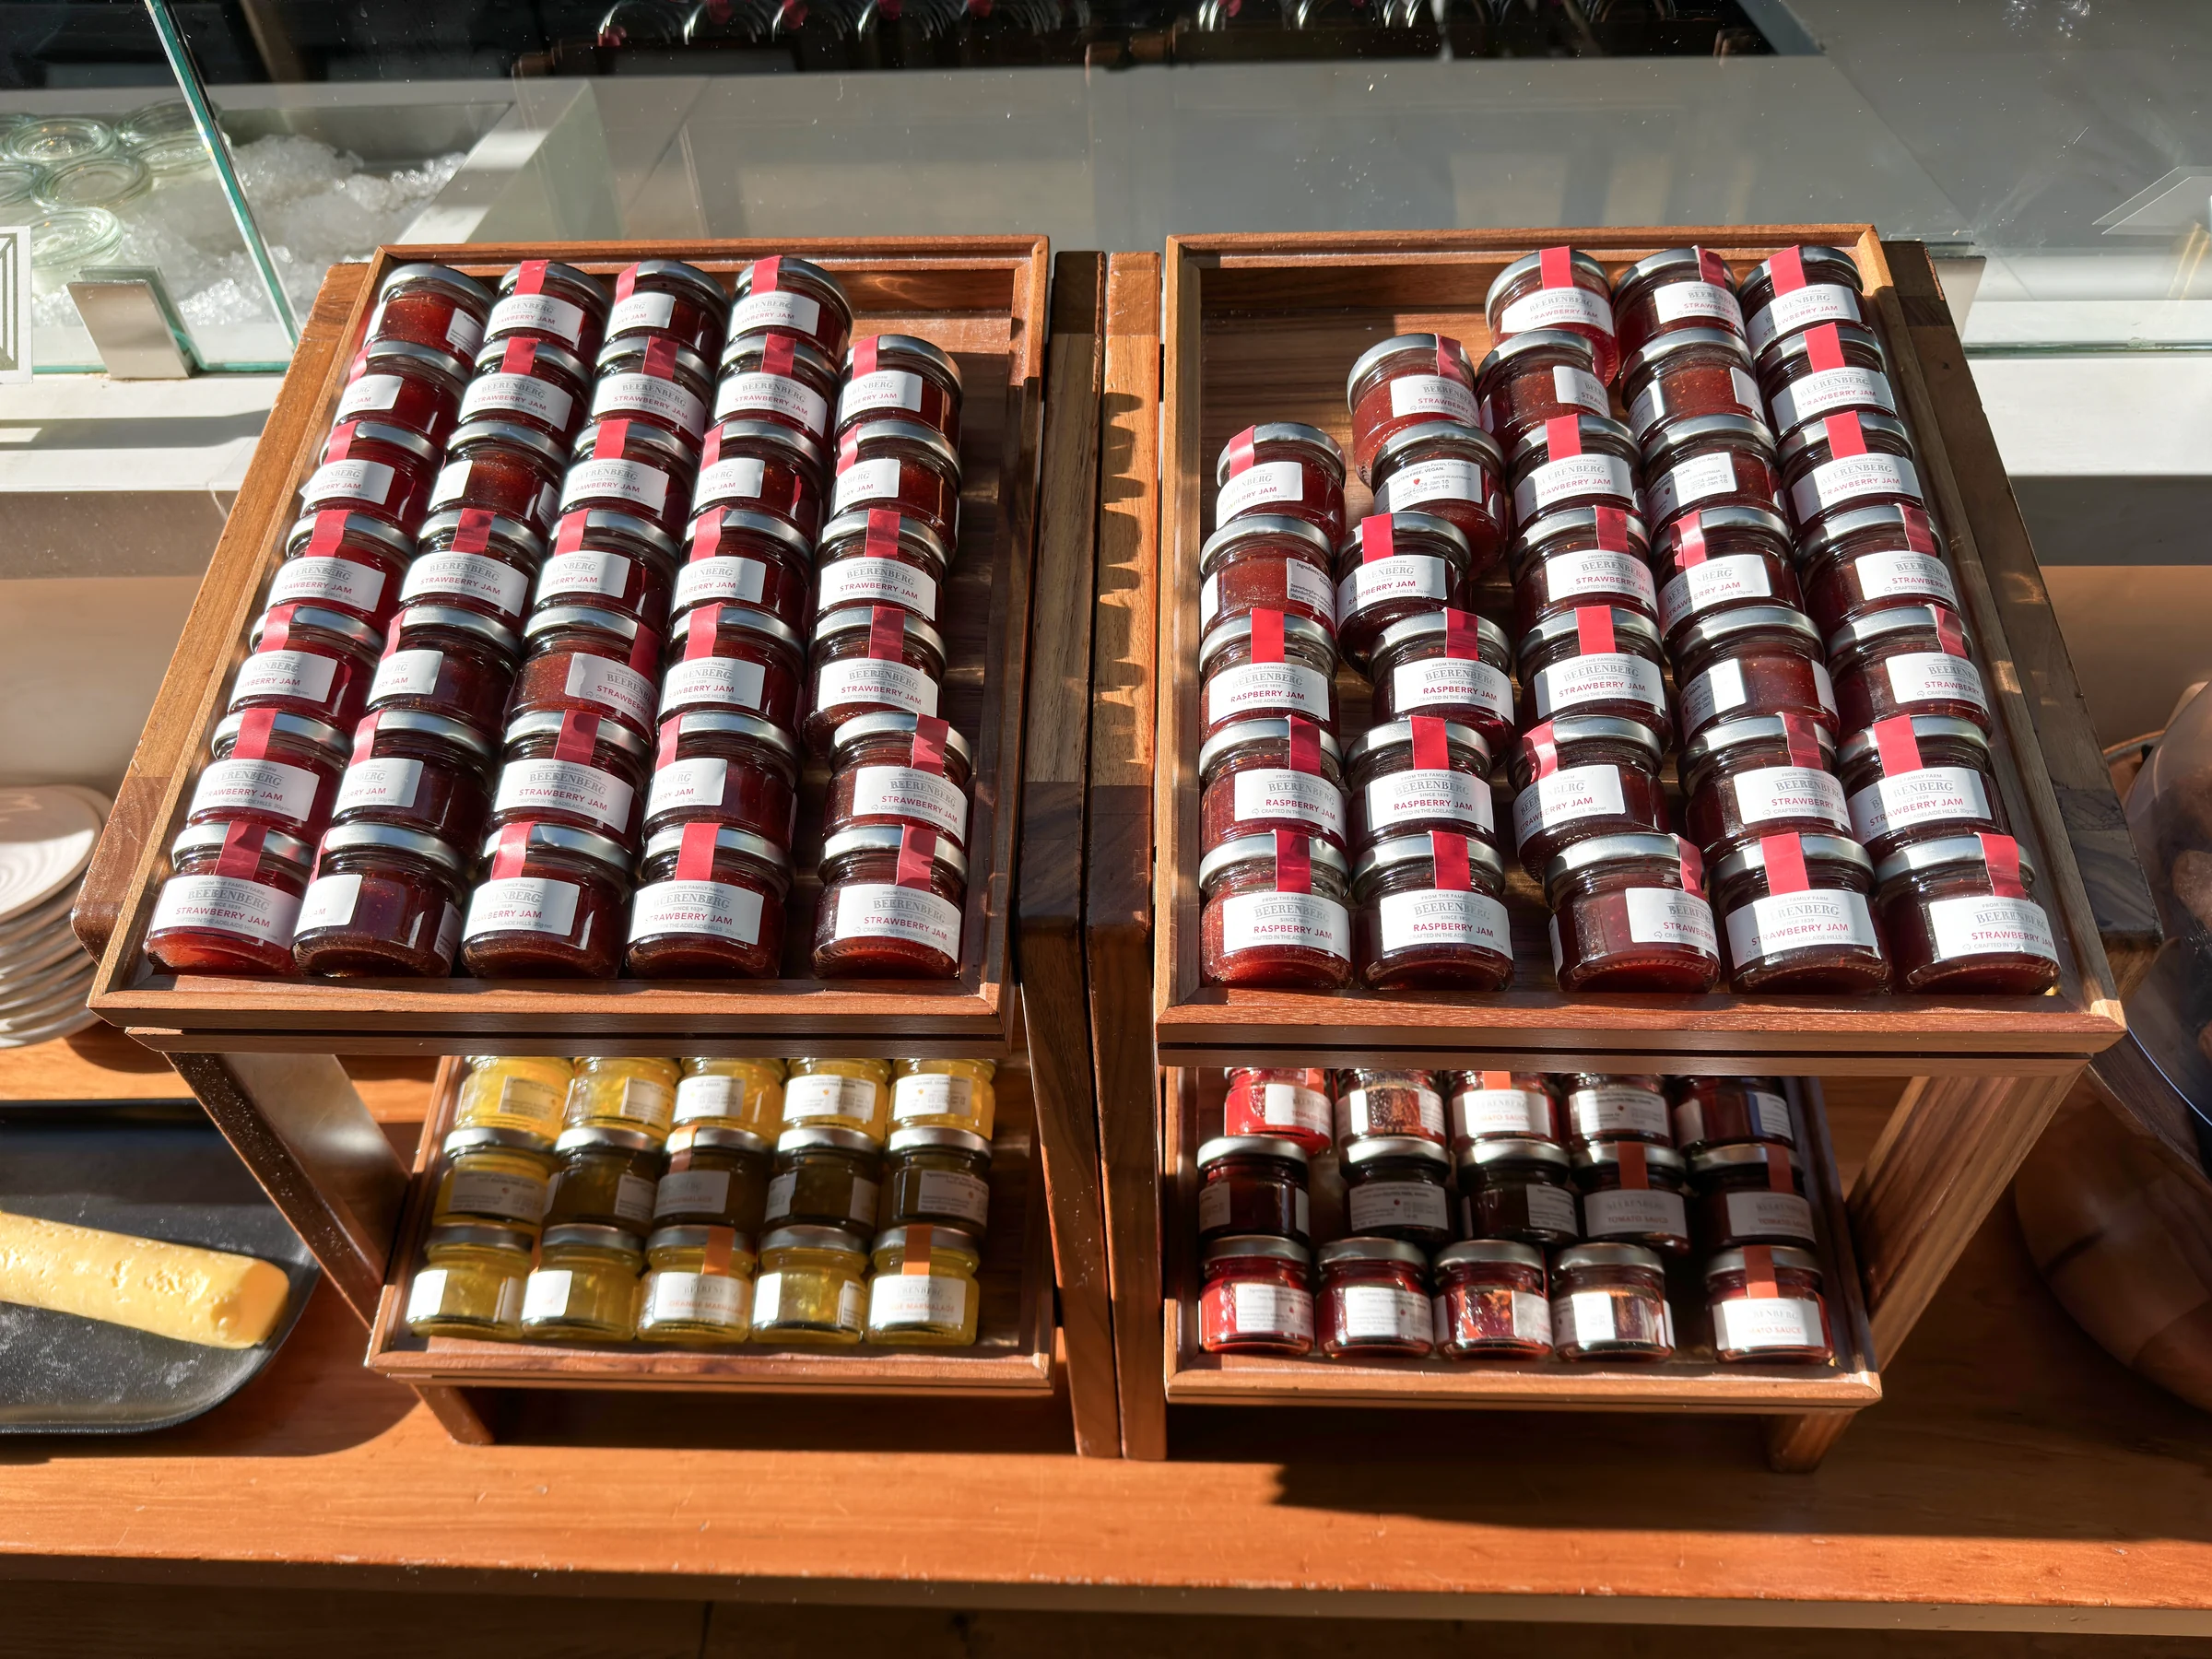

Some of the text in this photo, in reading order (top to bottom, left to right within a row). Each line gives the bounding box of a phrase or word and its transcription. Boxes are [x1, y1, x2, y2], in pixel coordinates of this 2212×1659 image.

[538, 315, 557, 325] JAM
[630, 312, 647, 321] JAM
[776, 312, 795, 321] JAM
[1583, 310, 1599, 320] JAM
[621, 382, 688, 407] BEERENBERG
[742, 382, 806, 404] BEERENBERG
[1859, 389, 1877, 397] JAM
[527, 400, 547, 412] JAM
[613, 394, 688, 421] STRAWBERRY JAM
[735, 394, 808, 417] STRAWBERRY JAM
[1418, 397, 1470, 414] STRAWBERRY
[620, 483, 641, 493] JAM
[717, 481, 736, 489] JAM
[856, 483, 874, 491] JAM
[1258, 487, 1277, 496] JAM
[429, 561, 500, 583] BEERENBERG
[846, 565, 915, 586] BEERENBERG
[331, 584, 353, 594] JAM
[420, 577, 500, 595] STRAWBERRY JAM
[1395, 580, 1417, 588] JAM
[1575, 575, 1636, 588] STRAWBERRY
[1719, 581, 1741, 592] JAM
[1891, 576, 1947, 591] STRAWBERRY
[840, 582, 918, 600] STRAWBERRY JAM
[1425, 669, 1496, 688] BEERENBERG
[1563, 662, 1640, 682] BEERENBERG
[279, 677, 301, 686] JAM
[391, 677, 409, 685] JAM
[849, 669, 918, 691] BEERENBERG
[713, 685, 735, 693] JAM
[841, 685, 922, 706] STRAWBERRY JAM
[1230, 689, 1305, 703] RASPBERRY JAM
[1423, 686, 1498, 701] RASPBERRY JAM
[1559, 680, 1647, 698] STRAWBERRY JAM
[1924, 680, 1980, 697] STRAWBERRY
[529, 771, 606, 795] BEERENBERG
[260, 791, 284, 801] JAM
[366, 787, 387, 795] JAM
[674, 787, 695, 797] JAM
[889, 780, 957, 808] BEERENBERG
[1267, 781, 1335, 806] BEERENBERG
[518, 788, 608, 812] STRAWBERRY JAM
[1394, 799, 1474, 812] RASPBERRY JAM
[1570, 796, 1594, 807] JAM
[1771, 797, 1834, 810] STRAWBERRY
[1941, 797, 1964, 806] JAM
[881, 795, 959, 824] STRAWBERRY JAM
[1265, 798, 1336, 821] RASPBERRY JAM
[187, 888, 269, 912] BEERENBERG
[176, 906, 271, 928] STRAWBERRY JAM
[518, 910, 542, 919] JAM
[873, 898, 947, 924] BEERENBERG
[1253, 903, 1330, 923] BEERENBERG
[710, 915, 733, 925] JAM
[864, 916, 947, 941] STRAWBERRY JAM
[1253, 924, 1333, 941] RASPBERRY JAM
[1413, 923, 1494, 938] RASPBERRY JAM
[1825, 924, 1849, 932] JAM
[1971, 931, 2040, 942] STRAWBERRY
